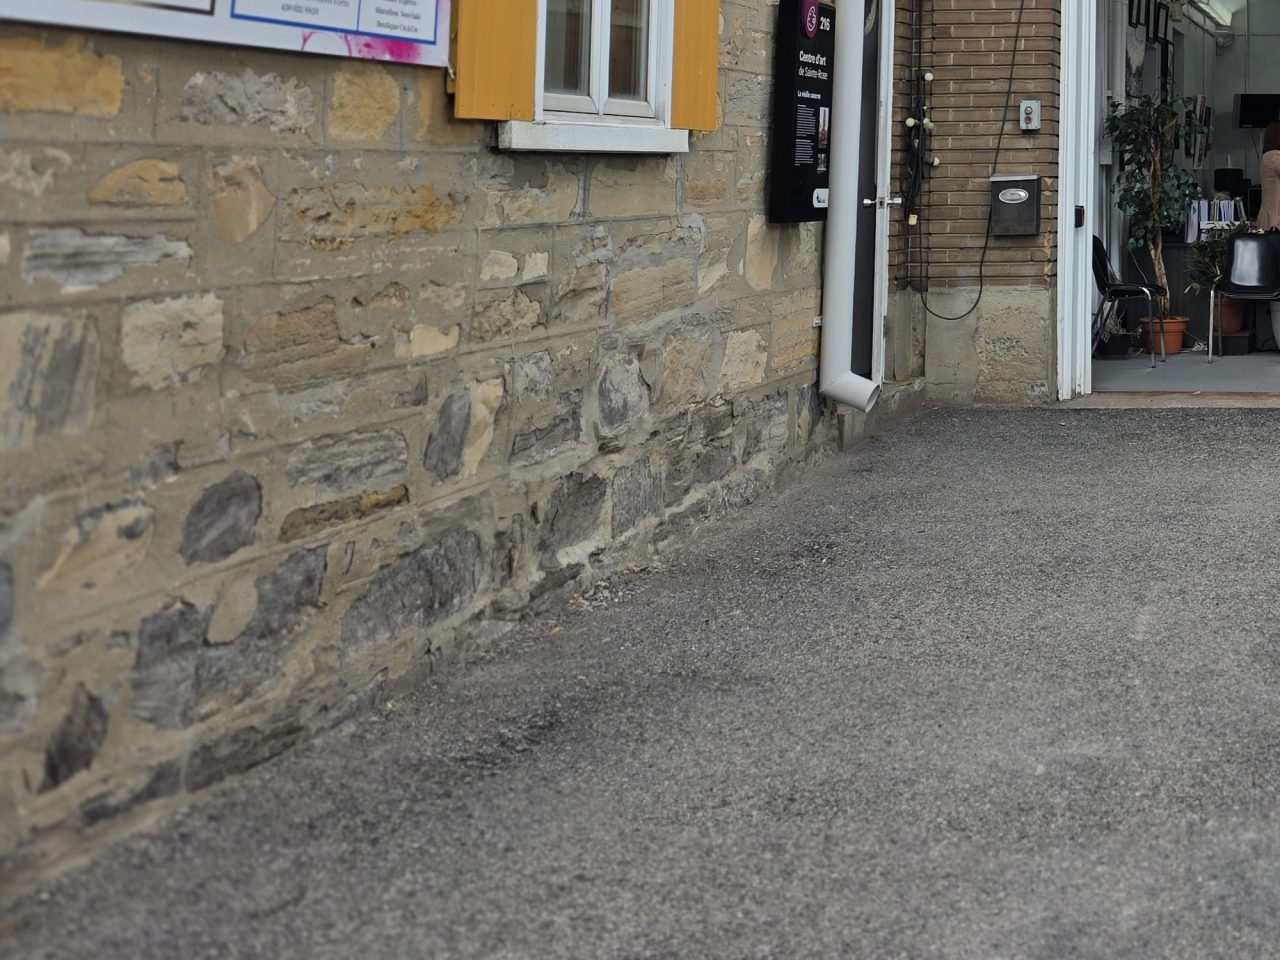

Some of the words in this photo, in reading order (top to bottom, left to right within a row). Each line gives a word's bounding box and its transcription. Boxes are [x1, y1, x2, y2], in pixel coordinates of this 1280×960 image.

[800, 50, 816, 64] Centre
[816, 53, 826, 66] d'art
[798, 66, 804, 76] de
[805, 67, 828, 80] Sainte-Rose
